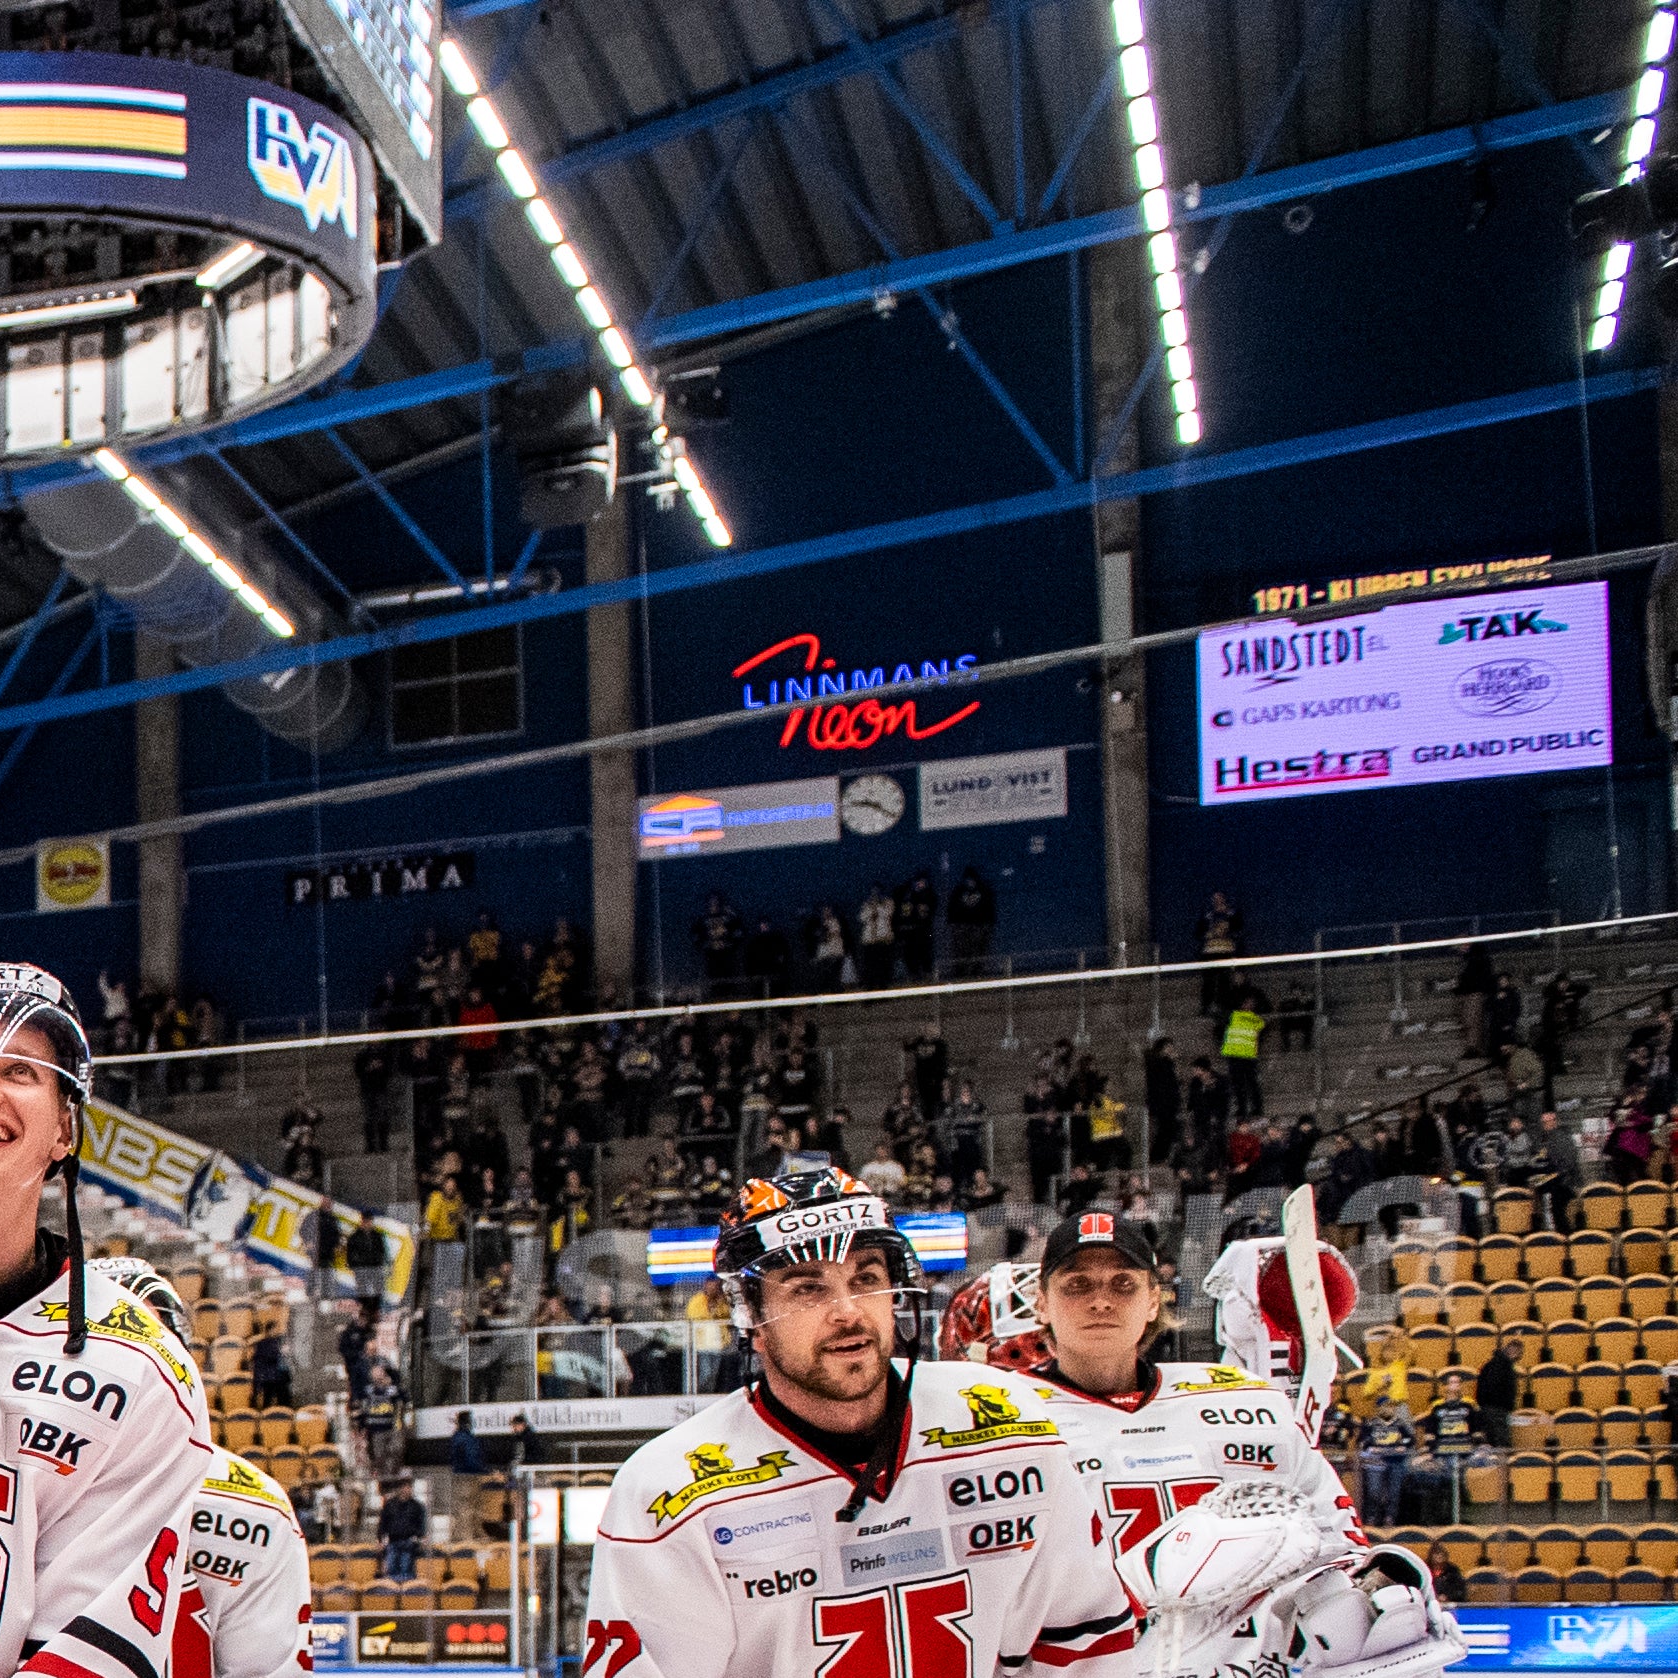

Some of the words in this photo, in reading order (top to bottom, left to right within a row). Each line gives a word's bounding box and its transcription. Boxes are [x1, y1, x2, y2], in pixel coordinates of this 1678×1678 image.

[1461, 609, 1545, 643] TAK
[1221, 625, 1368, 678] SANDSTEDT
[1298, 692, 1402, 720] KARTONG
[1412, 740, 1505, 764] GRAND
[1510, 729, 1606, 754] PUBLIC
[1215, 745, 1395, 788] Hestra
[294, 864, 464, 902] PRIMA
[18, 1417, 93, 1468] OBK
[1224, 1443, 1275, 1464] OBK
[733, 1510, 813, 1539] CONTRACTING
[968, 1515, 1038, 1550] OBK
[193, 1549, 251, 1580] OBK
[744, 1566, 819, 1599] rebro
